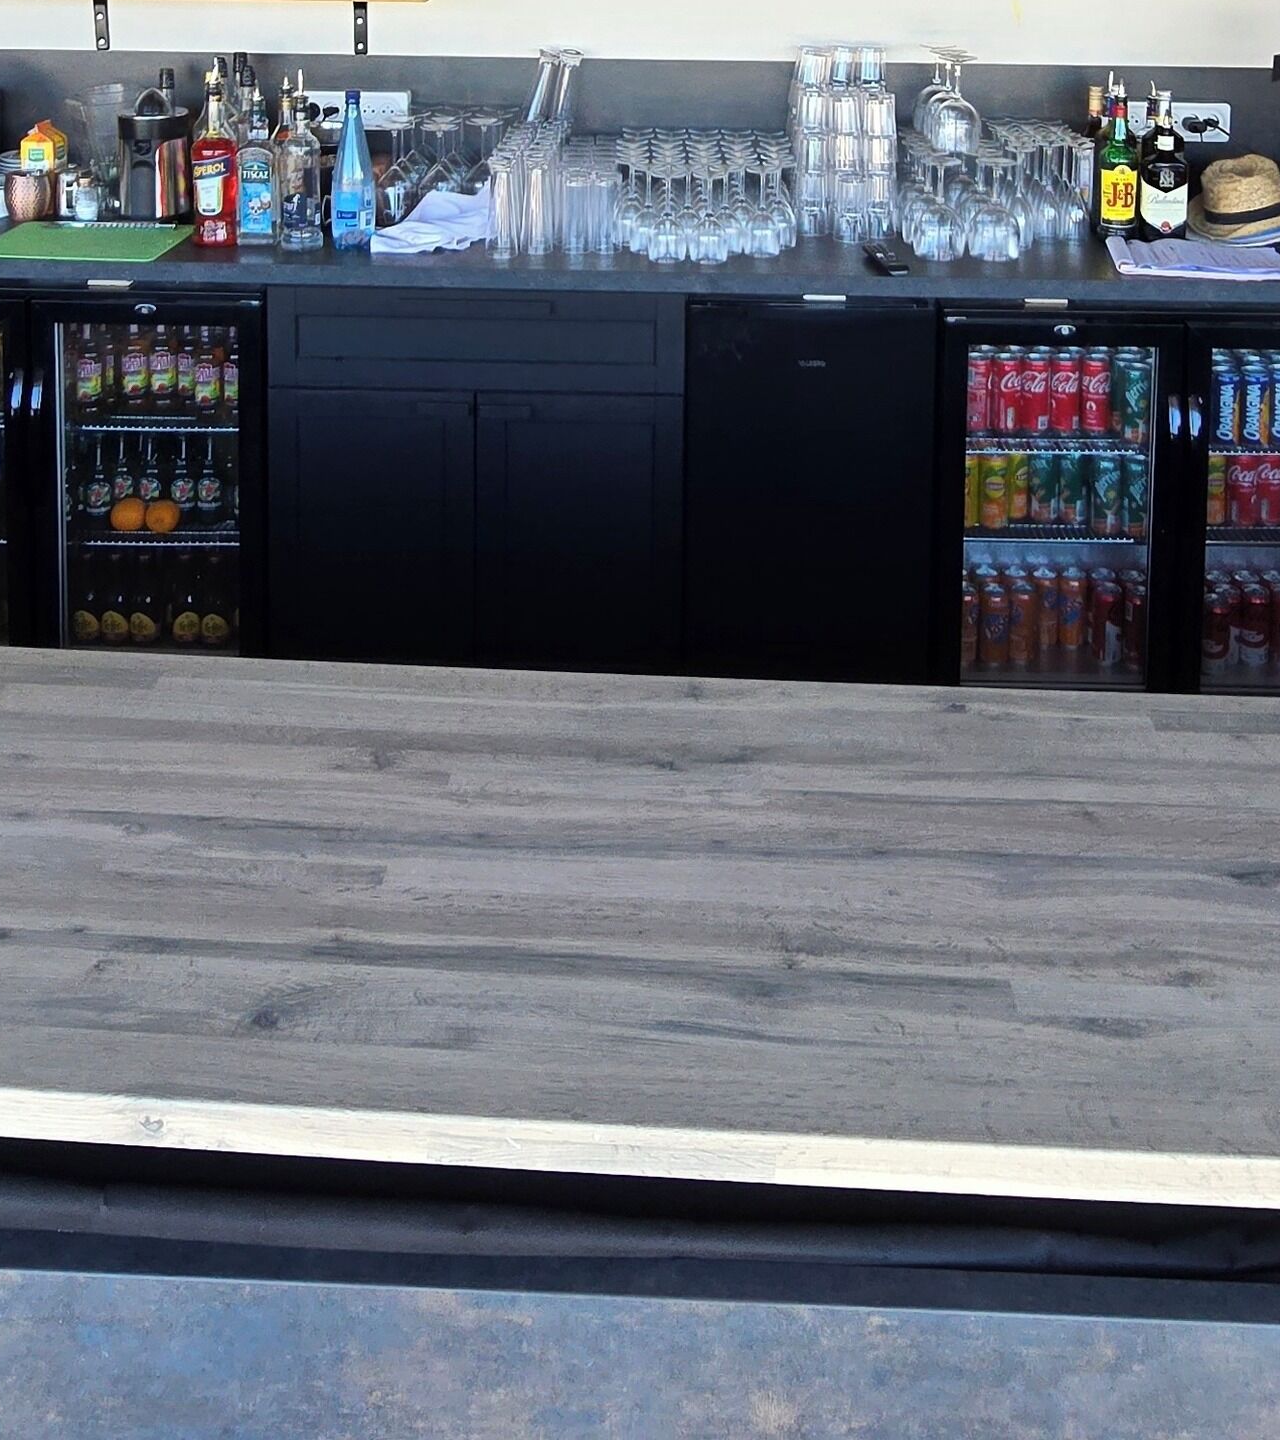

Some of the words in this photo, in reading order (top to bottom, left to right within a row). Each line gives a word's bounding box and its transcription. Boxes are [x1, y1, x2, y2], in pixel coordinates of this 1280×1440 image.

[1106, 182, 1134, 208] J&B
[1216, 383, 1235, 441] ORANGINA
[1243, 383, 1262, 441] ORANGINA
